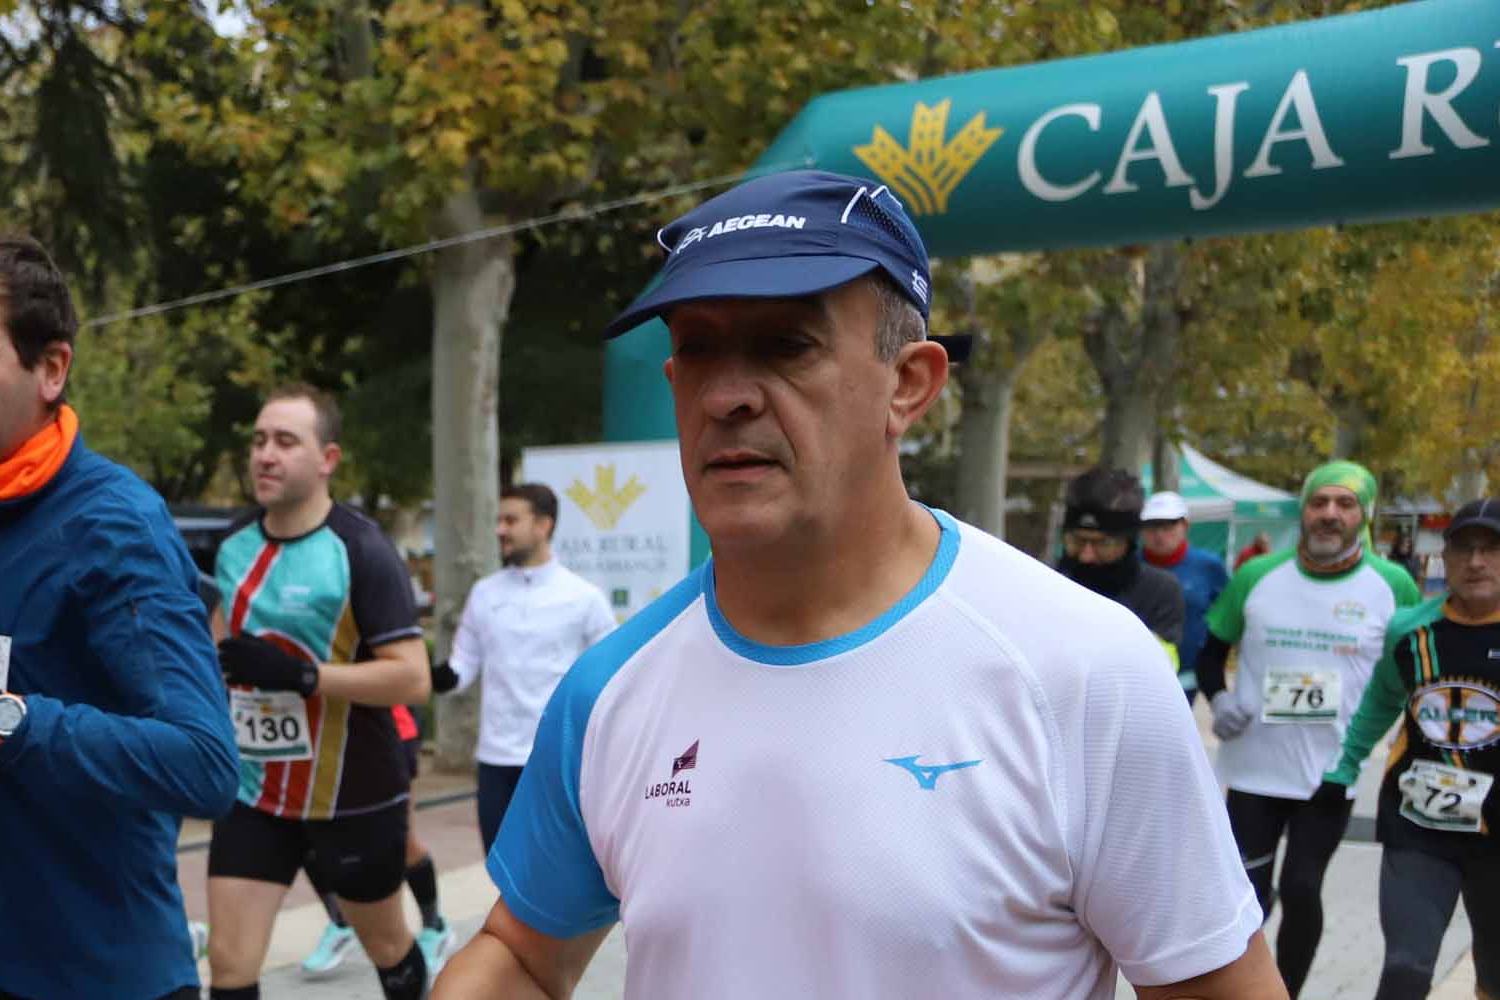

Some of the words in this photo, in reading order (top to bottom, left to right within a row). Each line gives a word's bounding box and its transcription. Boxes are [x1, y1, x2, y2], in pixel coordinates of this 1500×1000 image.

[1018, 68, 1345, 210] CAJA
[1389, 40, 1500, 160] R
[707, 214, 806, 238] AEGEAN
[246, 715, 300, 743] 130
[644, 779, 691, 800] LABORAL
[1424, 784, 1462, 814] 72
